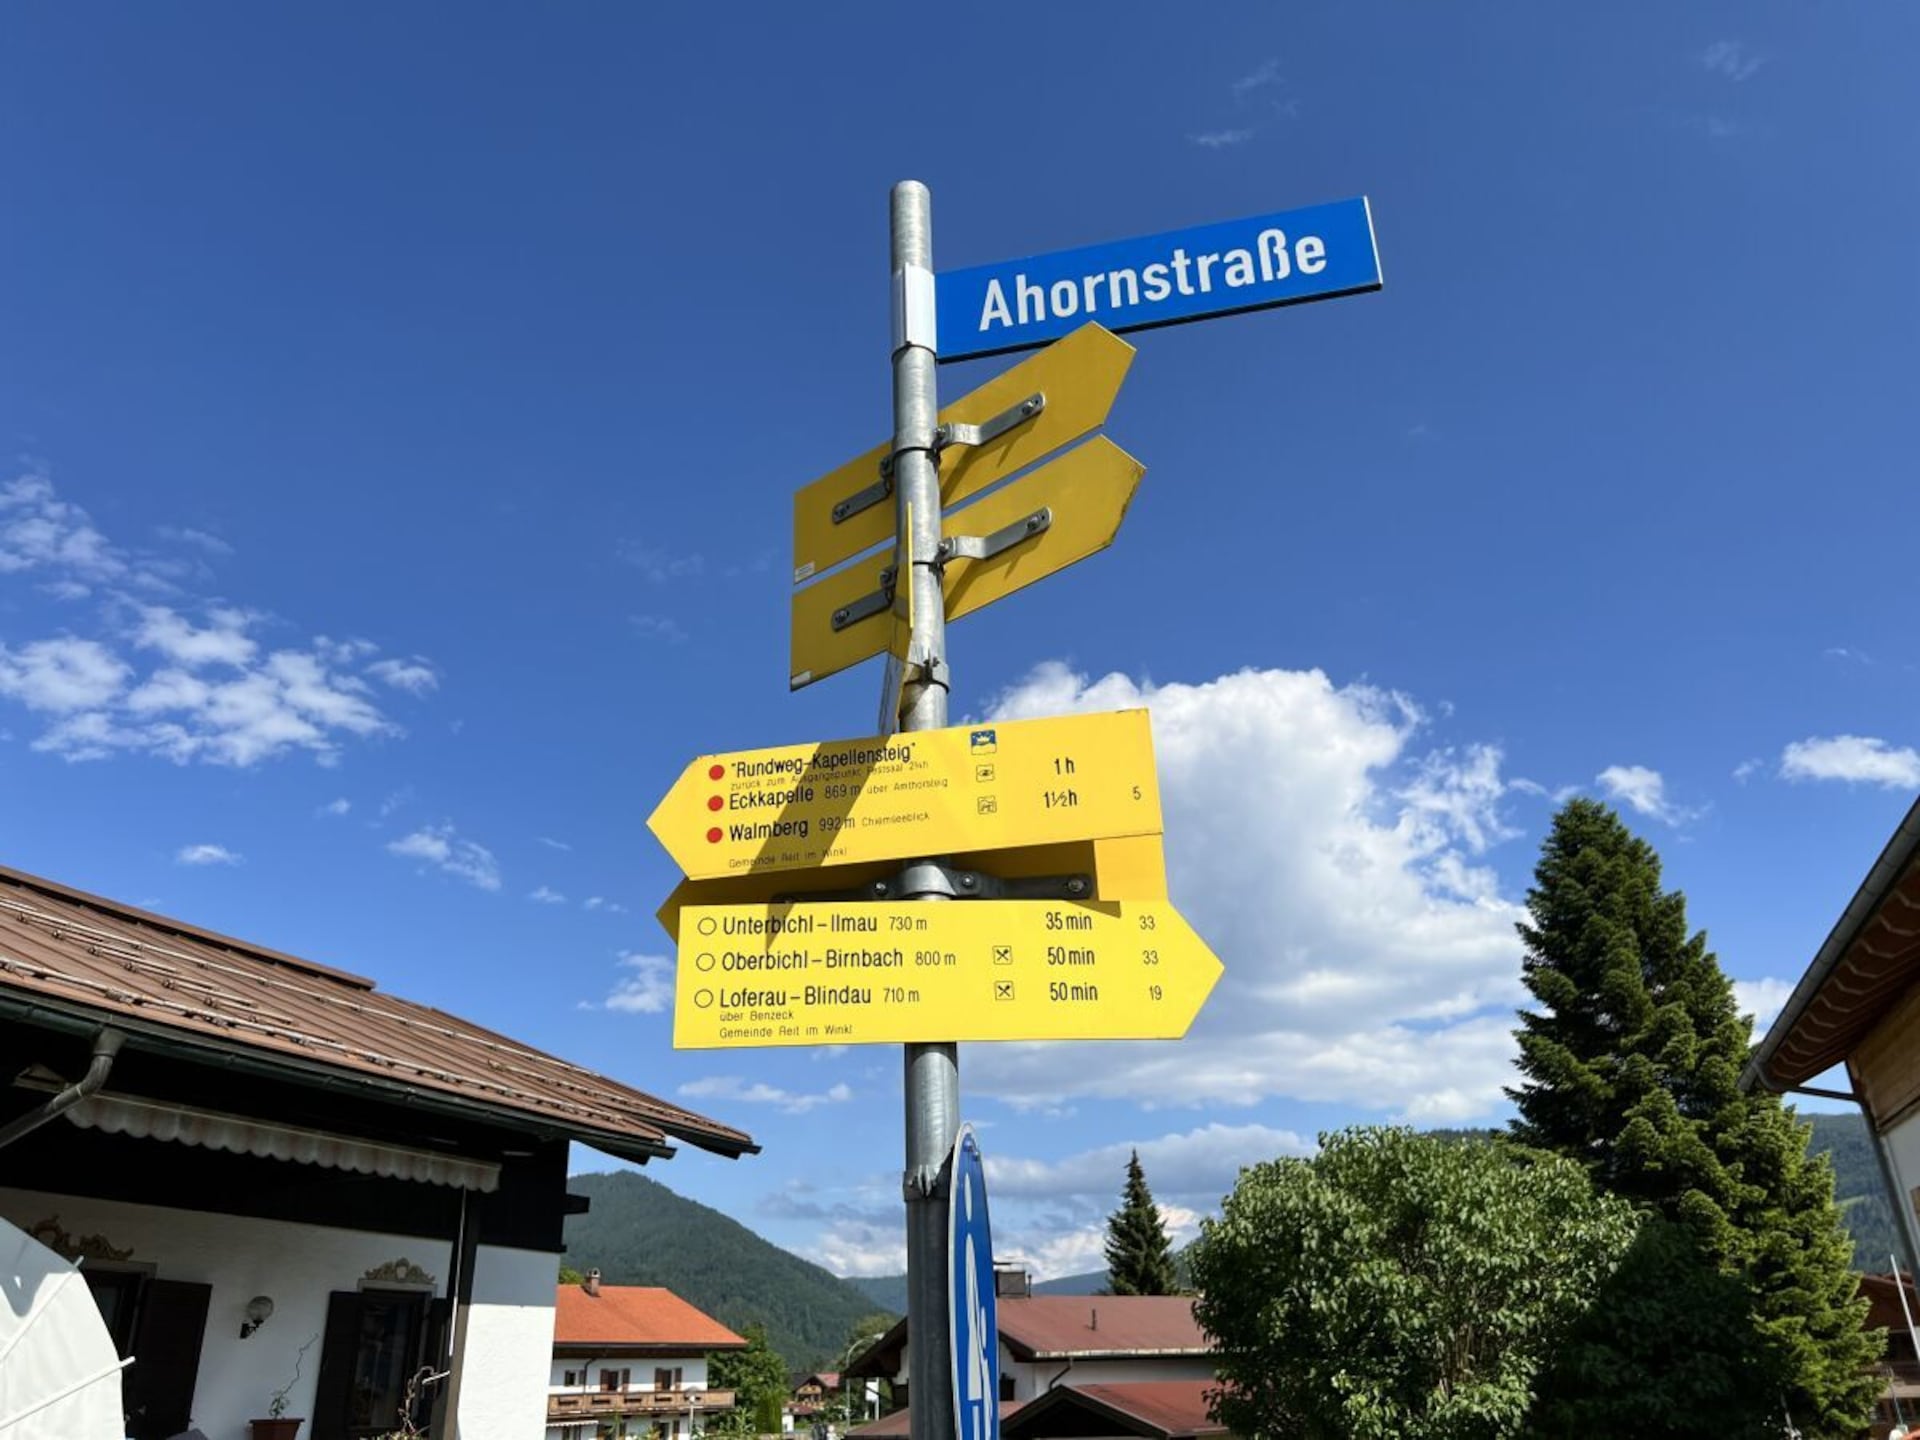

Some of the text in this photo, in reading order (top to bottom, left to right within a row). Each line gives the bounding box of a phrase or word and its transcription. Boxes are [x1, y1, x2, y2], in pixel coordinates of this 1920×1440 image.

[978, 228, 1327, 332] Ahornstraße
[1054, 756, 1075, 775] 1 h
[729, 784, 860, 810] Eckkapelle 869 m
[1132, 786, 1142, 800] 5
[729, 816, 855, 842] Walmberg 992 m
[723, 914, 814, 936] Unterbichl
[831, 914, 877, 932] Ilmau
[889, 916, 927, 931] 730 m
[1046, 911, 1092, 930] 35 min
[1139, 915, 1155, 930] 33
[721, 950, 808, 971] Oberbichl
[826, 949, 903, 969] Birnbach
[915, 951, 956, 966] 800 m
[1047, 946, 1095, 965] 50 min
[1142, 950, 1159, 965] 33
[720, 988, 786, 1008] Loferau
[804, 986, 871, 1005] Blindau
[883, 987, 920, 1003] 710 m
[1049, 982, 1098, 1001] 50 min
[1149, 986, 1162, 1000] 19
[720, 1010, 794, 1022] über Benzeck
[720, 1026, 773, 1039] Gemeinde
[779, 1025, 799, 1037] Reit
[806, 1026, 818, 1036] im
